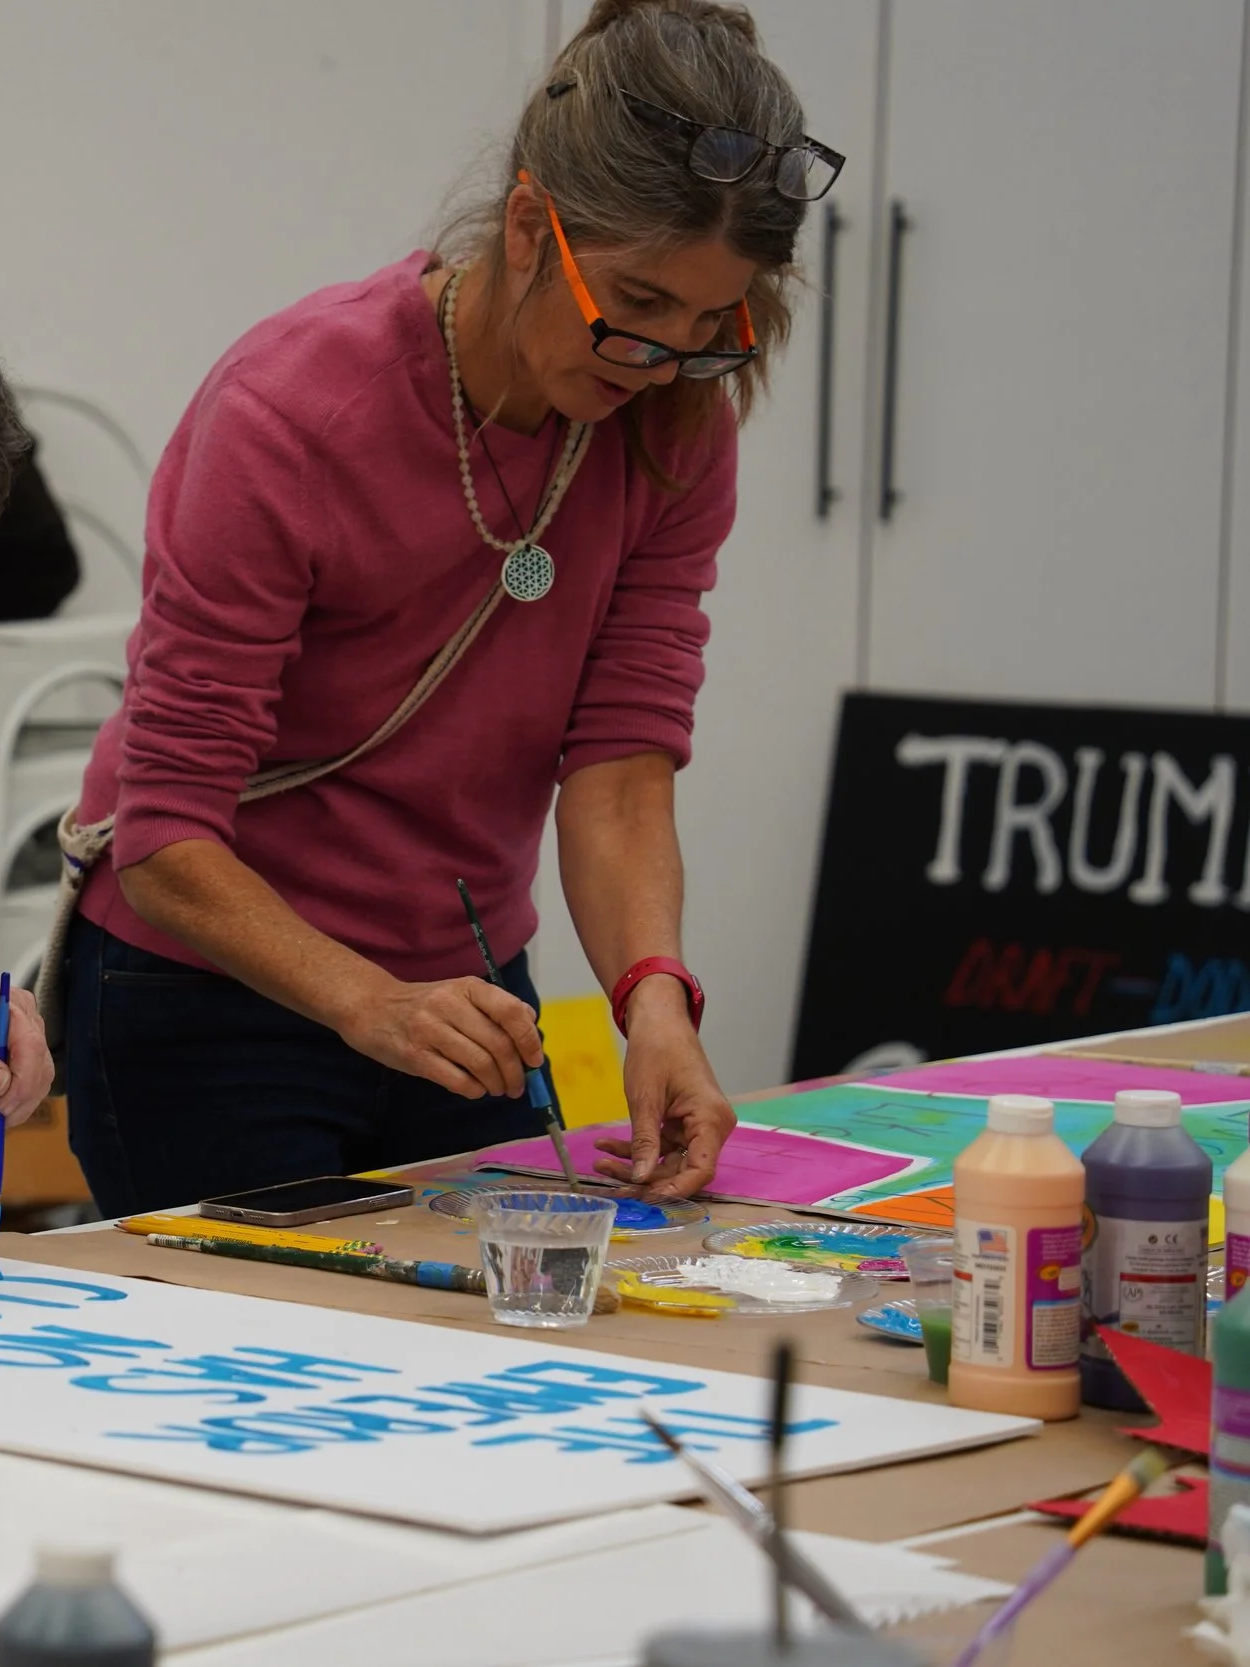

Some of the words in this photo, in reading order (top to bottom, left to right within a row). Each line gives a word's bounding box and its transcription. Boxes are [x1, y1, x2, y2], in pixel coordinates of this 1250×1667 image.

[895, 731, 1250, 912] TRUM
[70, 1347, 403, 1405] HAS
[101, 1361, 708, 1454] EMPEROR
